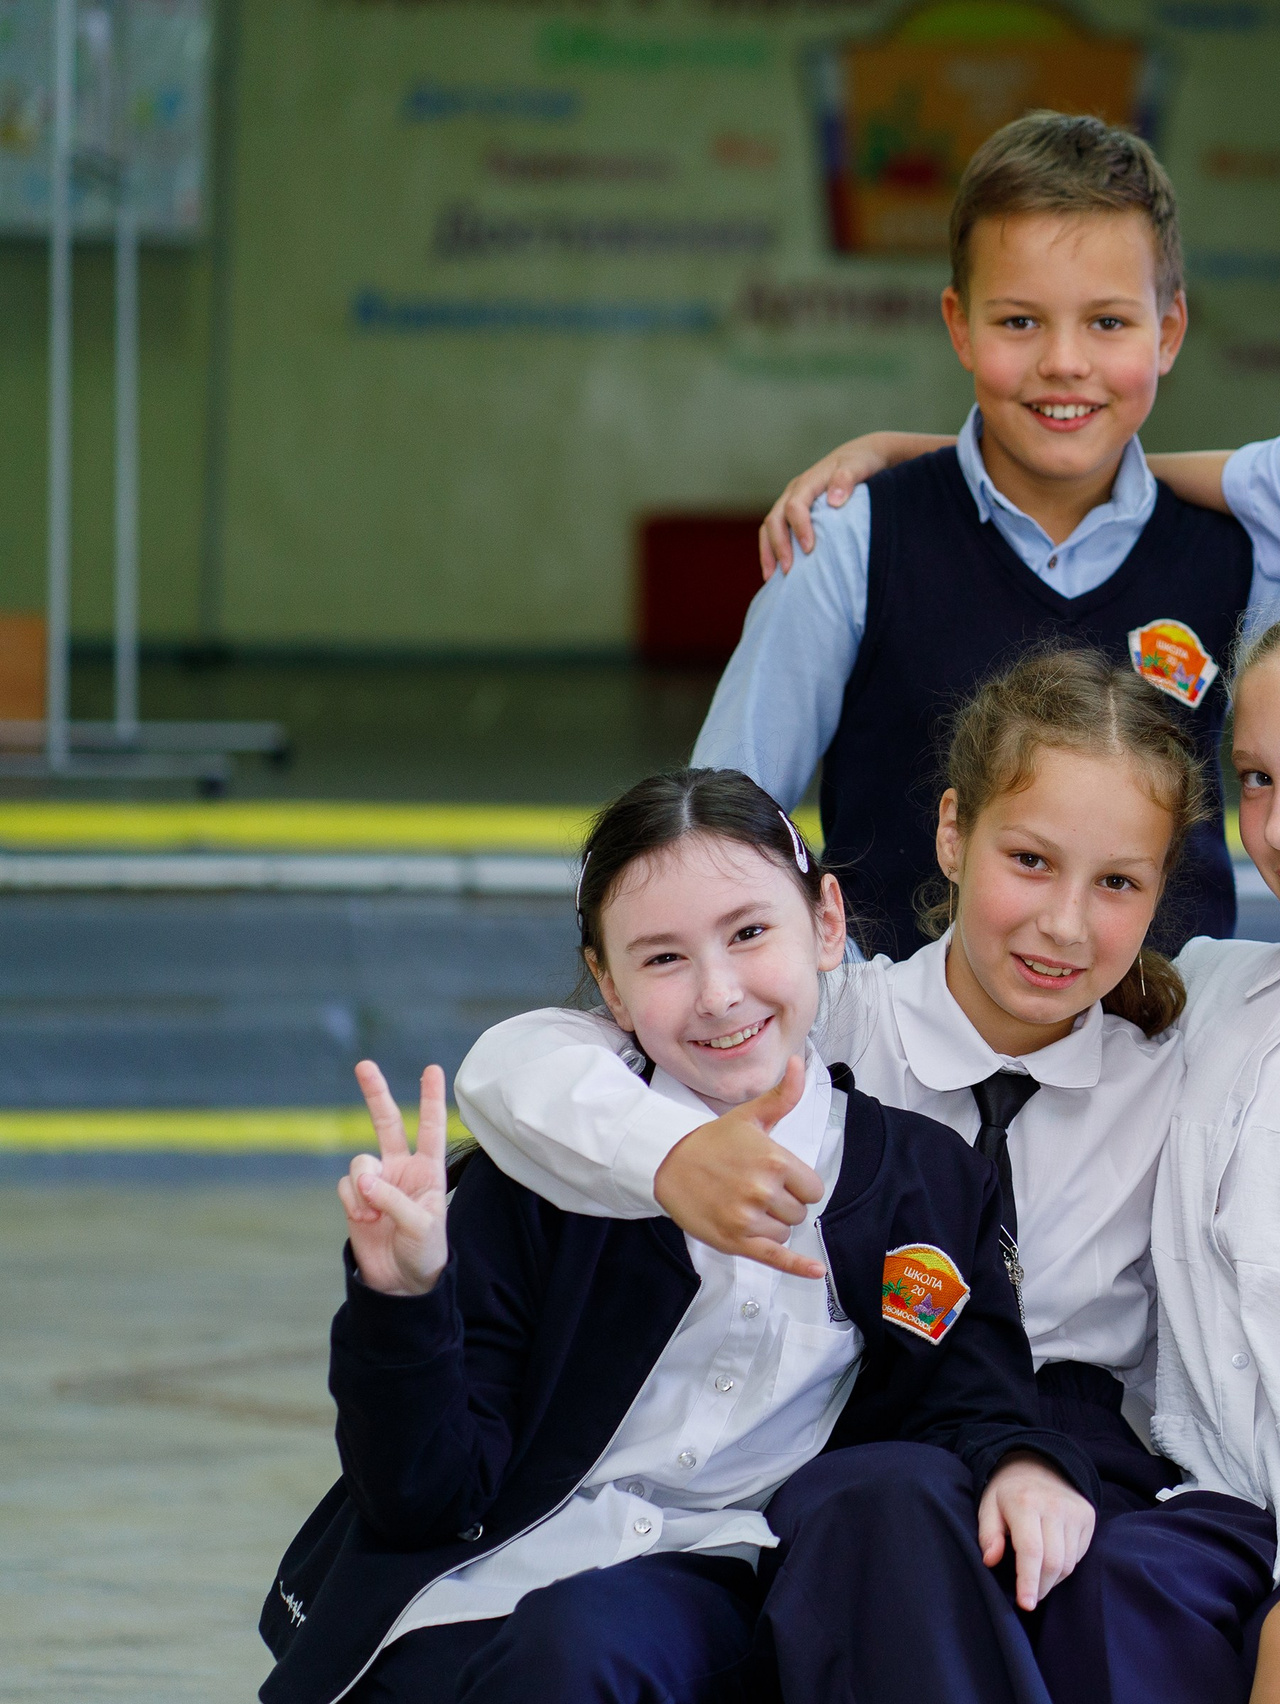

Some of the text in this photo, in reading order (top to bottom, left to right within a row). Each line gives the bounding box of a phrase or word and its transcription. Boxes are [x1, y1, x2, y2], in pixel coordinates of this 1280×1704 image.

[903, 1266, 943, 1291] ШКОЛА
[911, 1284, 925, 1297] 20
[882, 1304, 933, 1332] ОВОМОСКОВСК
